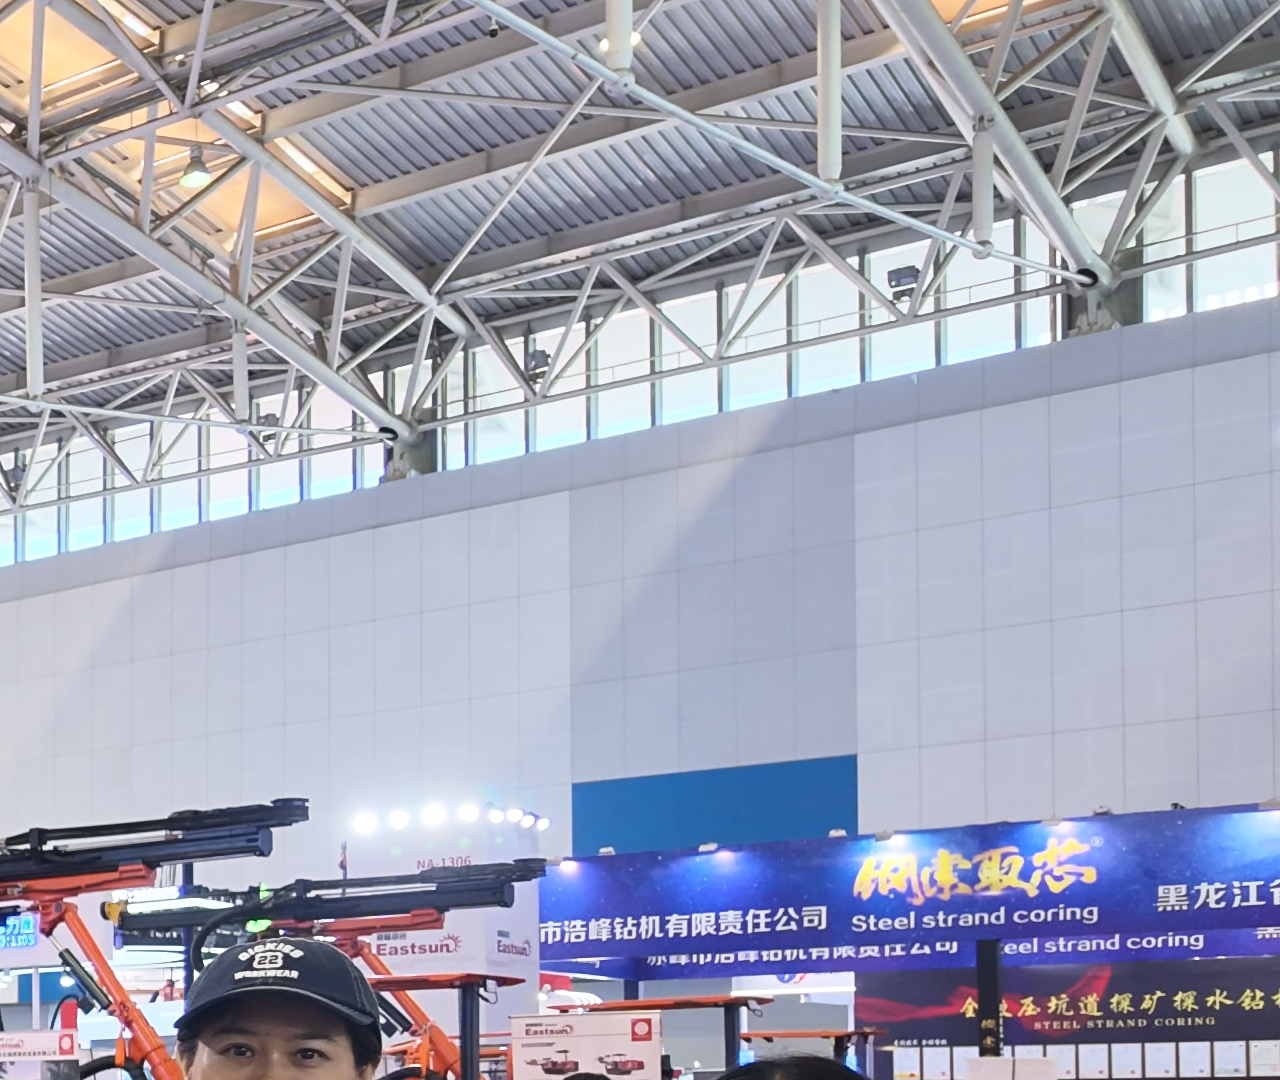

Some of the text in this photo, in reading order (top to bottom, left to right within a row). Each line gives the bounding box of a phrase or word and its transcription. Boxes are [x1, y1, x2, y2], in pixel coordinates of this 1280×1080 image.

[539, 905, 828, 945] 市浩峰钻机有限责任公司
[851, 904, 1099, 933] Steel strand coring
[376, 941, 453, 957] Eastsun
[497, 940, 530, 957] Eastsun
[1044, 934, 1120, 953] strand
[1126, 931, 1205, 950] coring
[257, 954, 279, 966] 22
[234, 969, 299, 980] WORKWEAR
[1033, 1016, 1217, 1030] STEEL STRAND CORING
[524, 1027, 570, 1036] Eastsun
